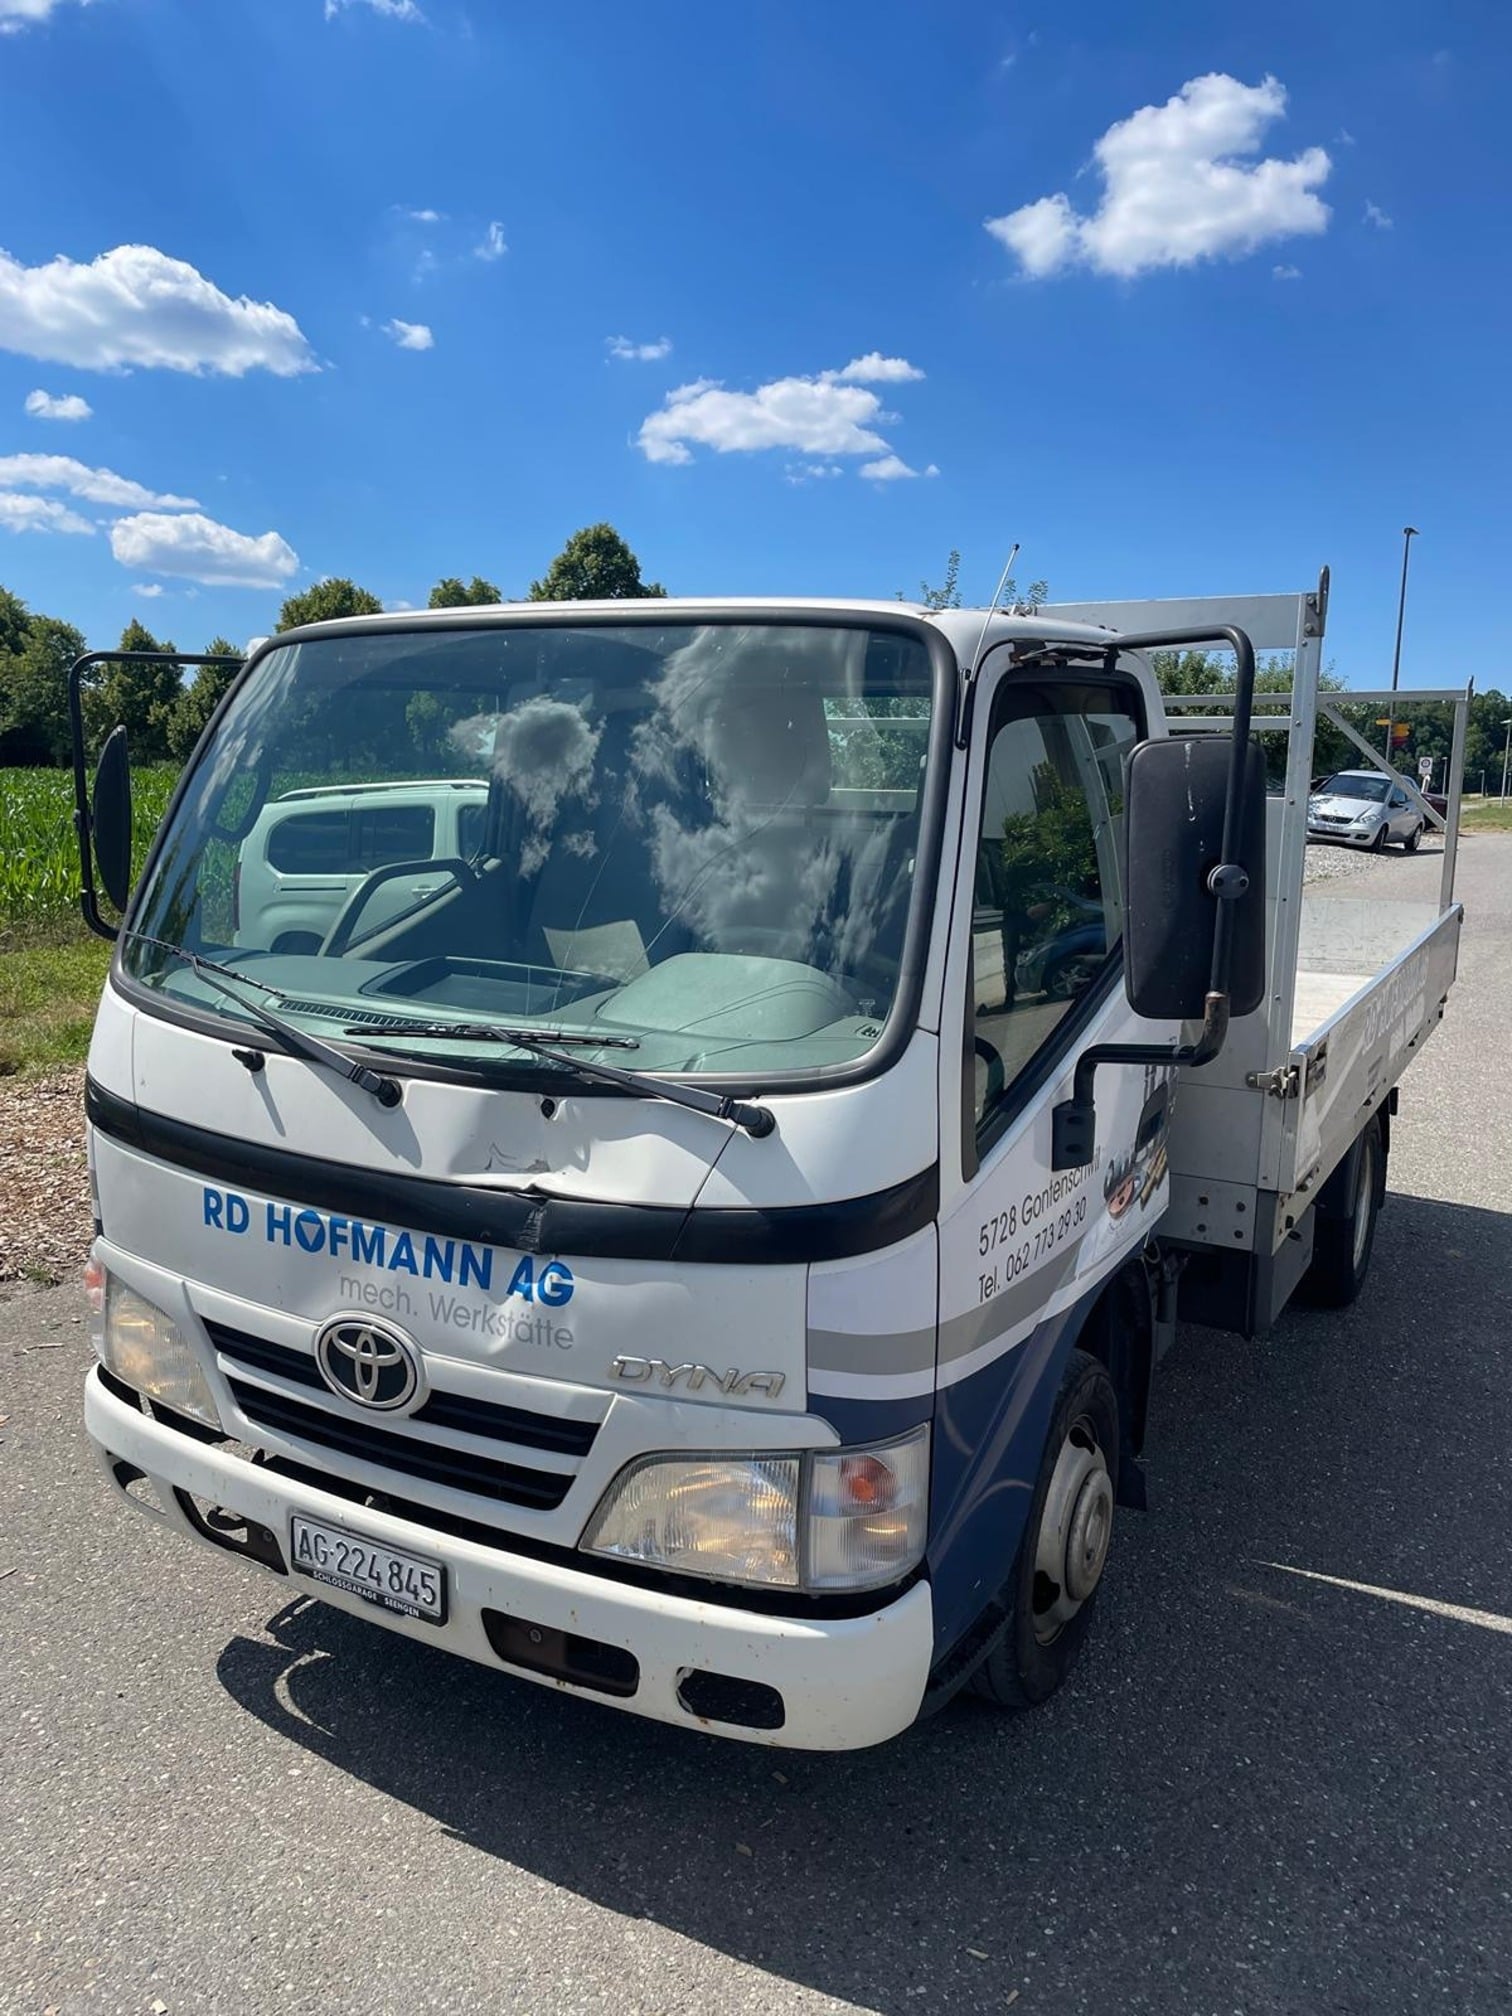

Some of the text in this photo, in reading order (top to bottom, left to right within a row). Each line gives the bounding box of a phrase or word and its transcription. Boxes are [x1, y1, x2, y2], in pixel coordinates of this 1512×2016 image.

[203, 1187, 574, 1307] RD HOFMANN AG
[979, 1205, 1016, 1256] 5728
[979, 1196, 1086, 1303] Tel. 062 773 29 30
[340, 1276, 574, 1351] mech. Werkstätte
[608, 1354, 786, 1400] DYNA
[312, 1570, 420, 1618] SCHLOSSGARAGE SEENGEN
